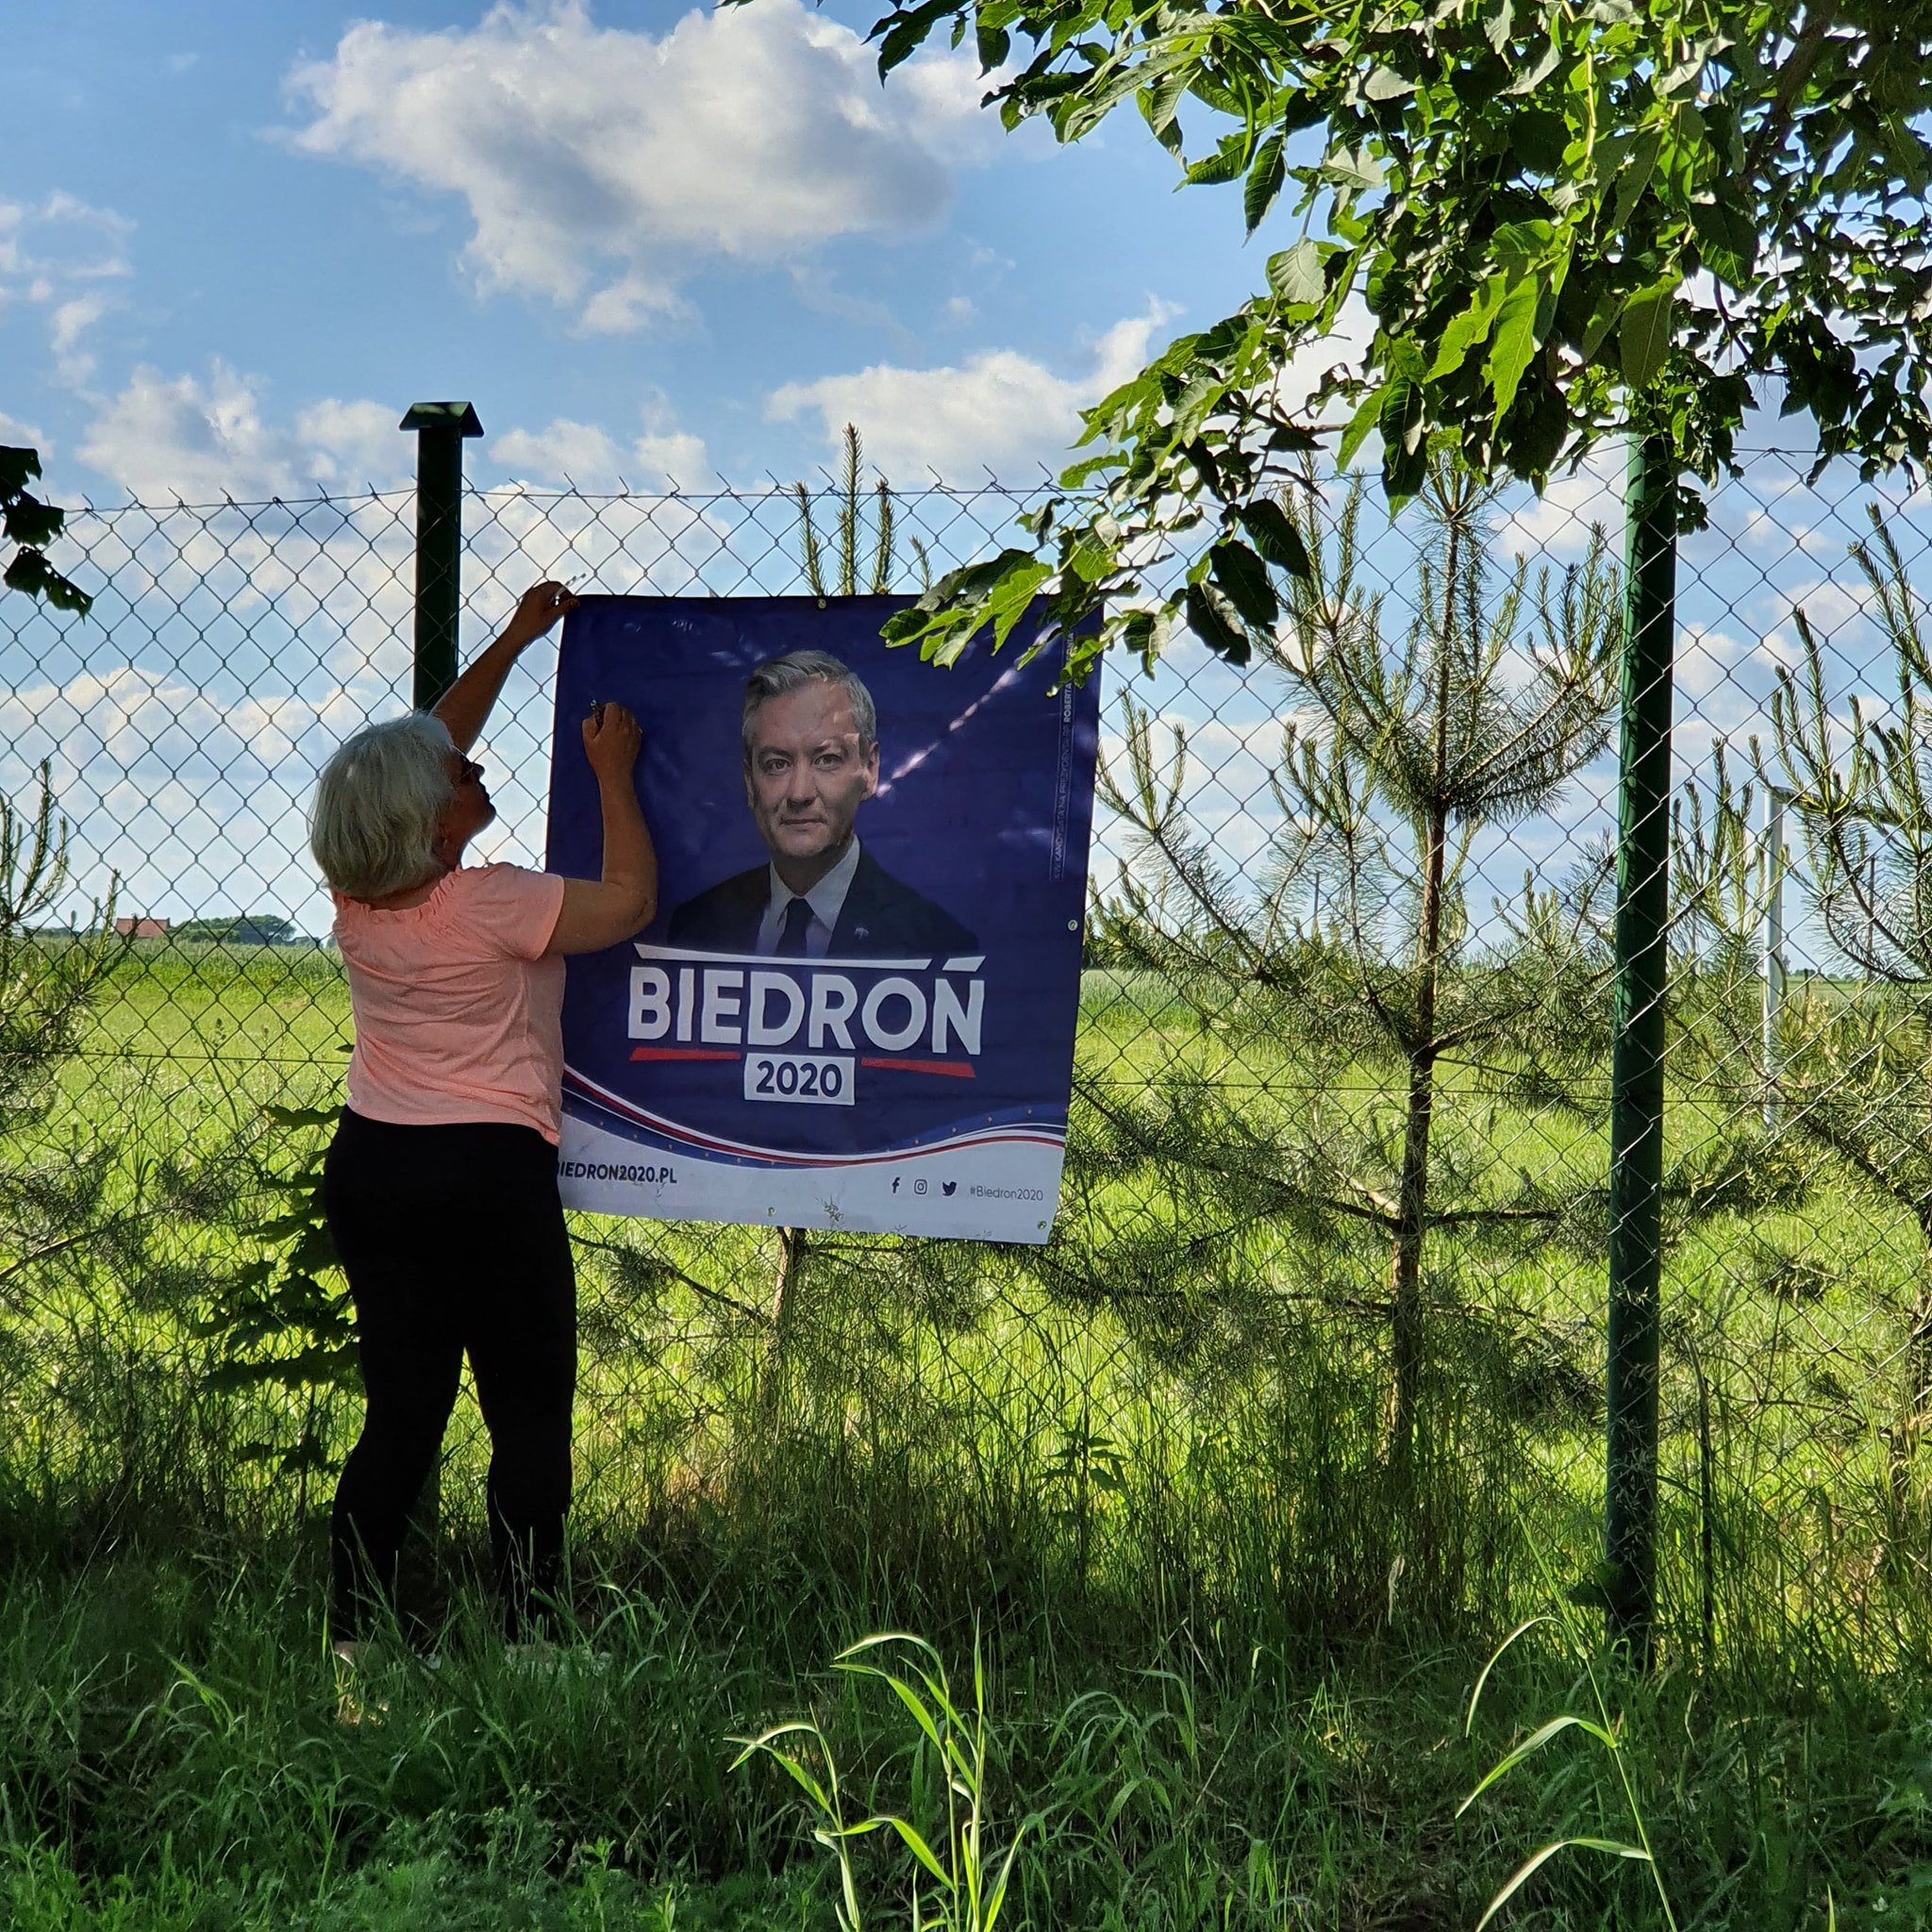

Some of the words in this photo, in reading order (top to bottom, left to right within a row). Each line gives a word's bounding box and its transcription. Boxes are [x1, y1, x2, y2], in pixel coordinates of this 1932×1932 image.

[1063, 683, 1073, 723] ROBERTA
[627, 956, 986, 1055] BIEDROŃ
[756, 1060, 842, 1098] 2020
[557, 1161, 677, 1184] IEDRON2020.PL
[970, 1186, 1044, 1201] #Biedron2020
